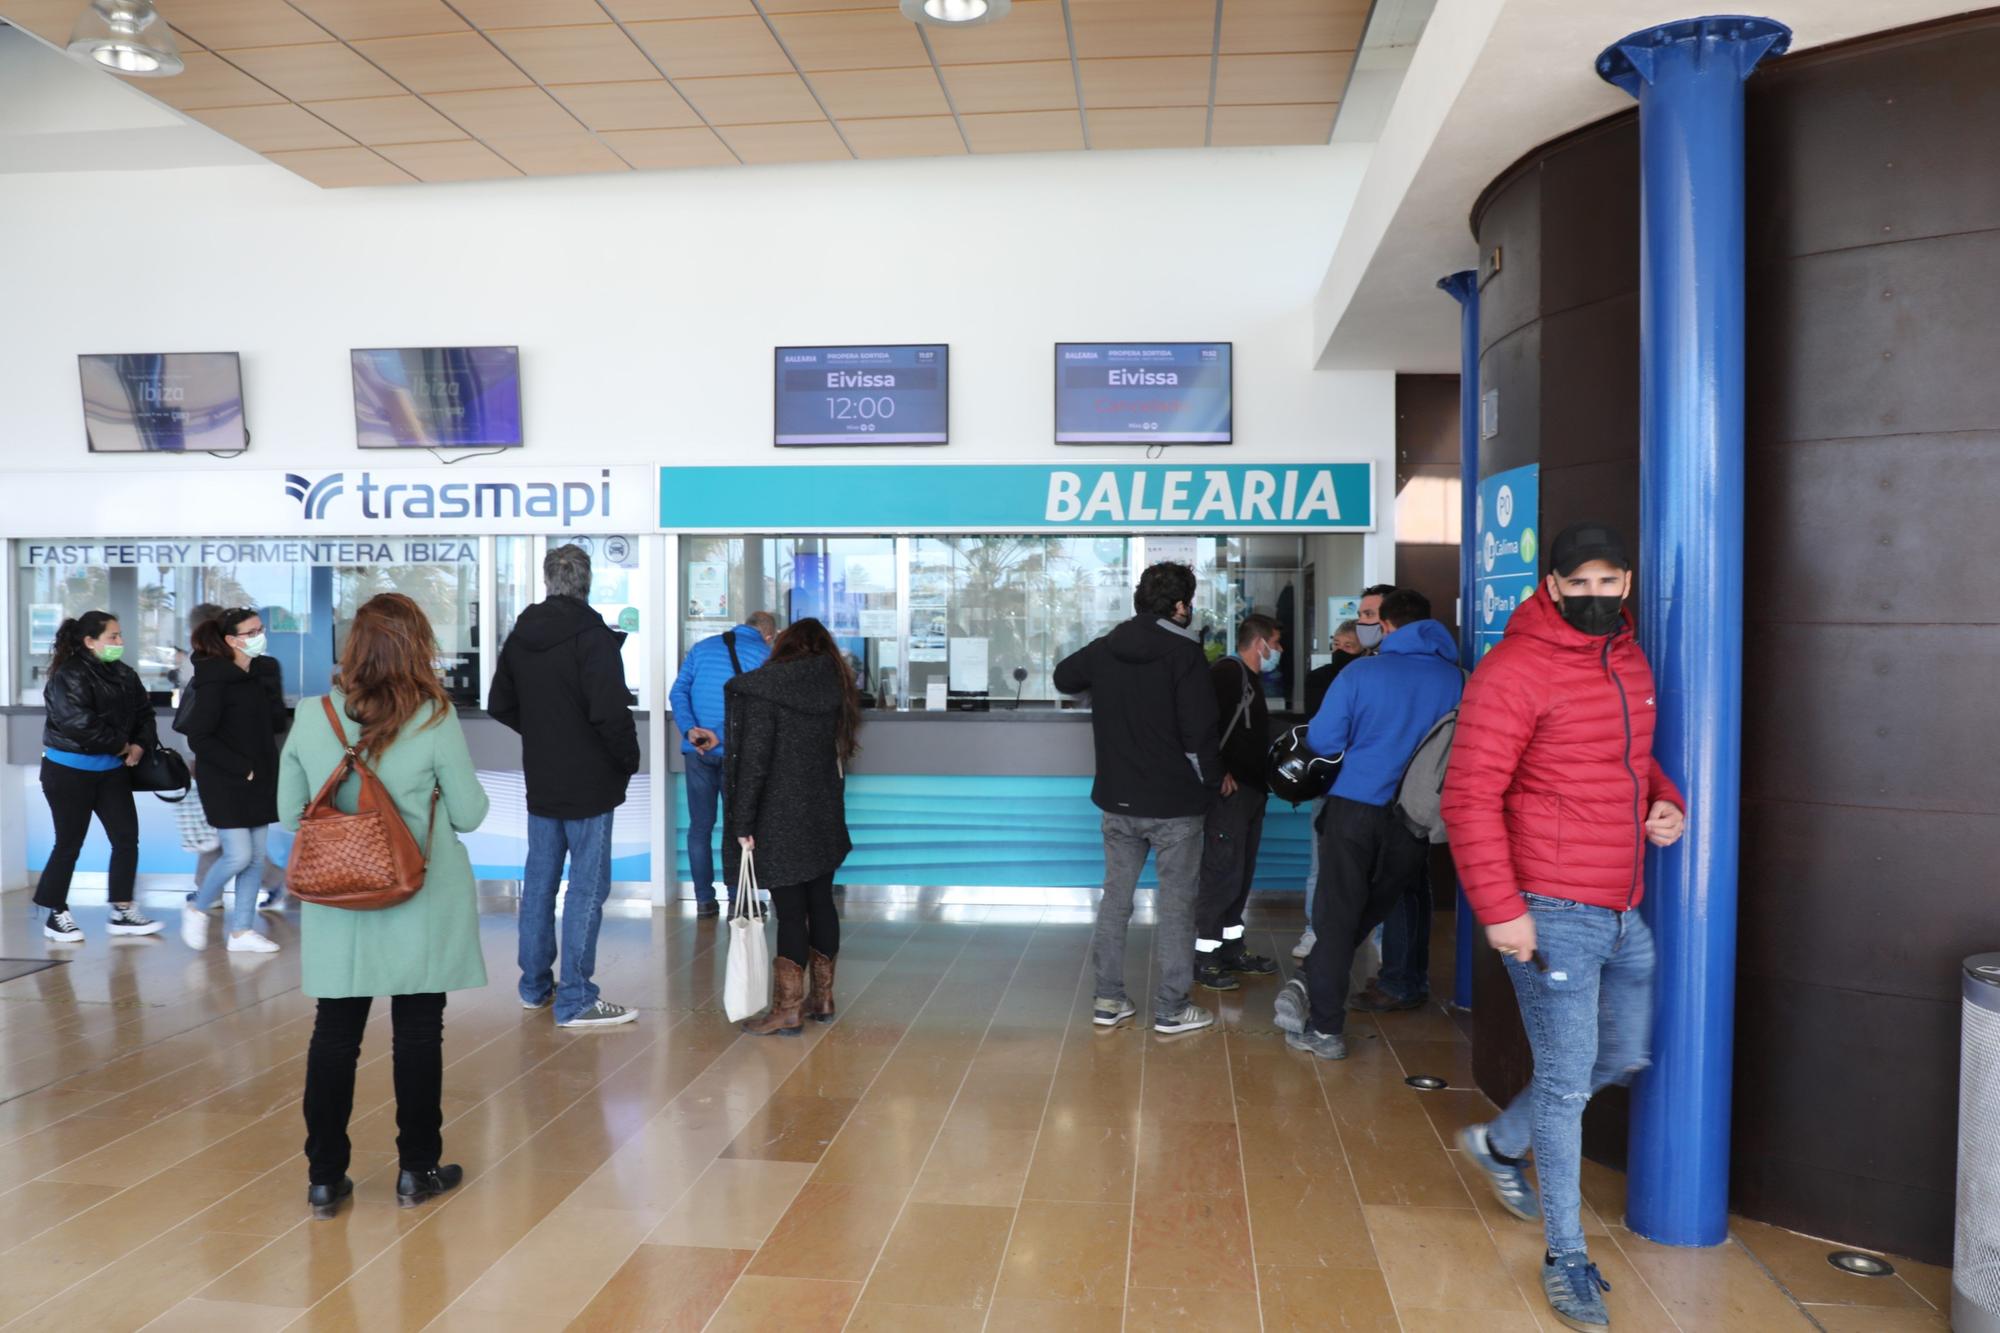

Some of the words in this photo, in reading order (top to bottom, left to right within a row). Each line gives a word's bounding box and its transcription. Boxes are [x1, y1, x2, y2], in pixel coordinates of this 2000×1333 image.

[826, 371, 896, 388] Eivissa
[1108, 369, 1178, 386] Eivissa
[139, 382, 185, 401] Ibiza
[826, 396, 896, 419] 12:00
[356, 469, 610, 527] trasmapi
[29, 545, 94, 564] FAST
[103, 544, 191, 564] FERRY
[200, 543, 393, 563] FORMENTERA
[404, 543, 476, 562] IBIZA
[1495, 539, 1519, 557] Calima
[1494, 597, 1509, 612] Plan
[1509, 596, 1516, 611] B
